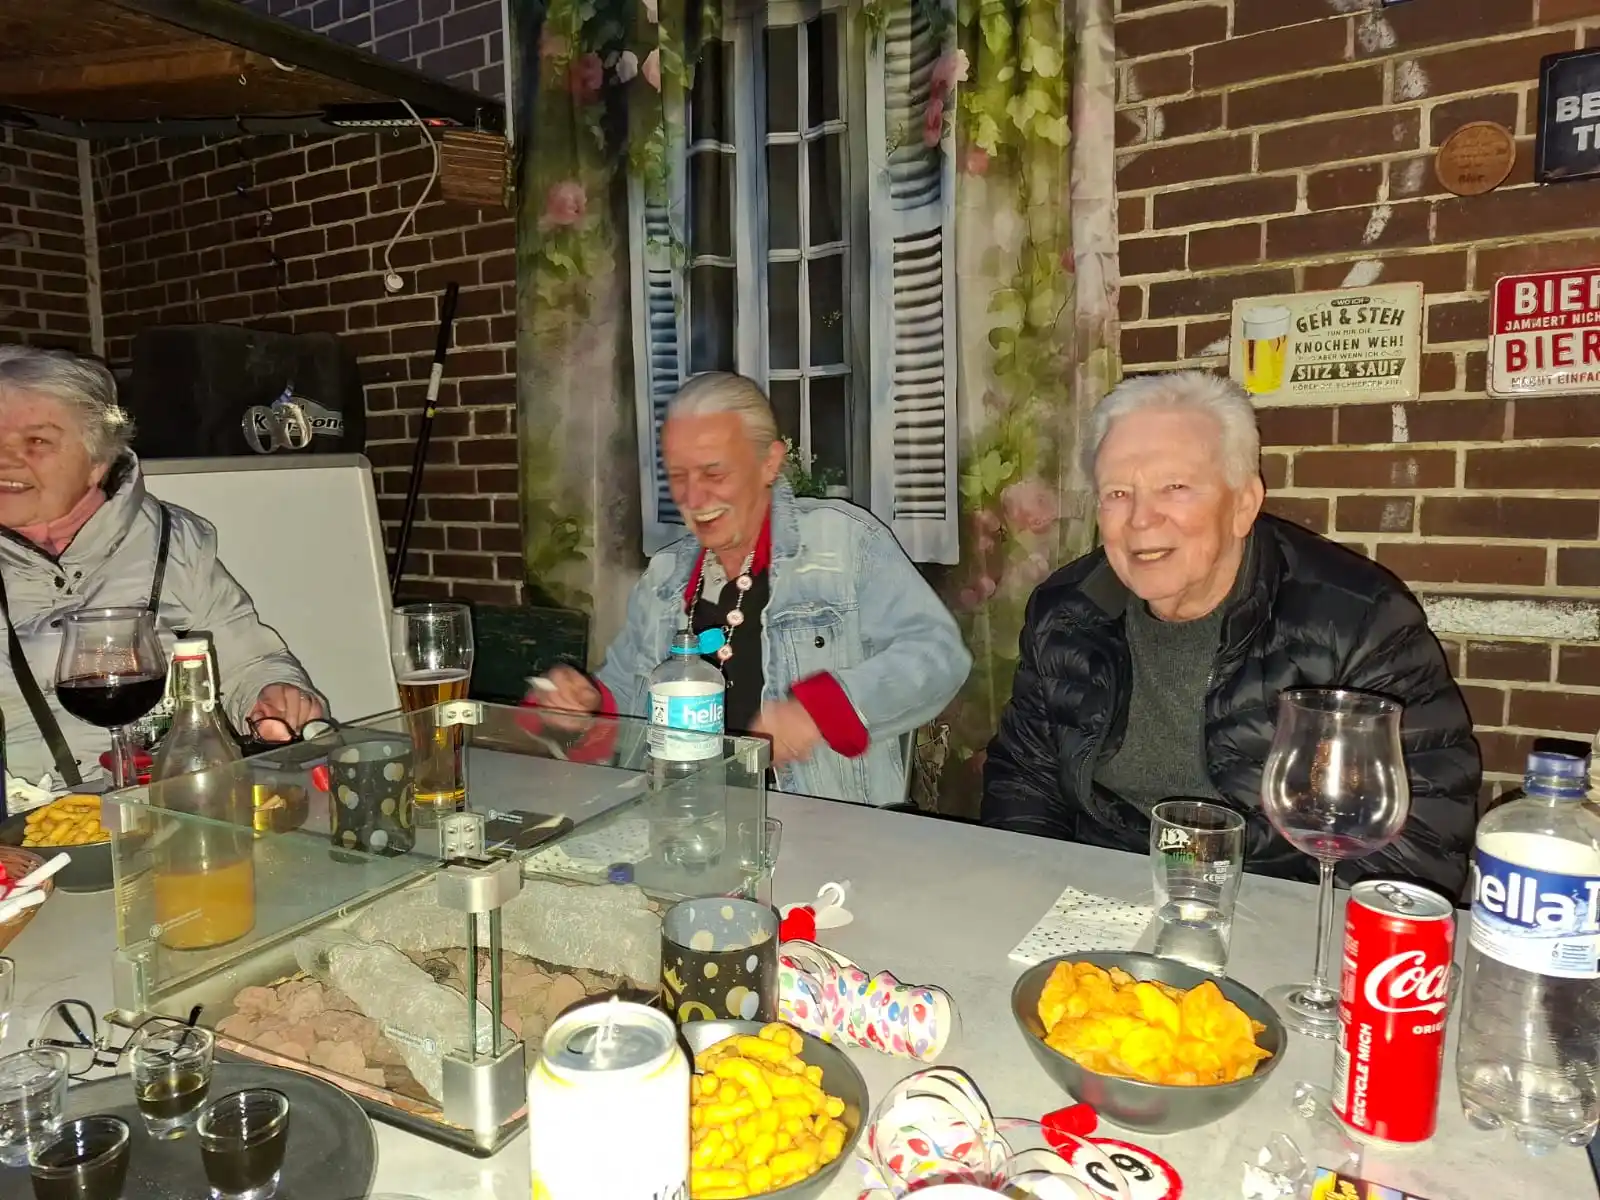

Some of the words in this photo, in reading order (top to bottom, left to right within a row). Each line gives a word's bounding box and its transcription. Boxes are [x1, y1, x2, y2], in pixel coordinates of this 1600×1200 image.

[1555, 91, 1600, 123] BE
[1296, 310, 1332, 333] GEH
[1339, 307, 1352, 325] &
[1357, 306, 1405, 326] STEH
[1504, 314, 1567, 331] JAMMERT
[1358, 327, 1372, 335] DIE
[1295, 338, 1360, 355] KNOCHEN
[1368, 335, 1404, 348] WEH!
[1506, 330, 1600, 373] BIER
[1318, 353, 1337, 361] ABER
[1297, 364, 1333, 380] SITZ
[1339, 363, 1350, 378] &
[1356, 360, 1400, 377] SAUF
[683, 703, 724, 725] hella
[1356, 1022, 1372, 1062] MICH
[1352, 1062, 1370, 1127] RECYCLE
